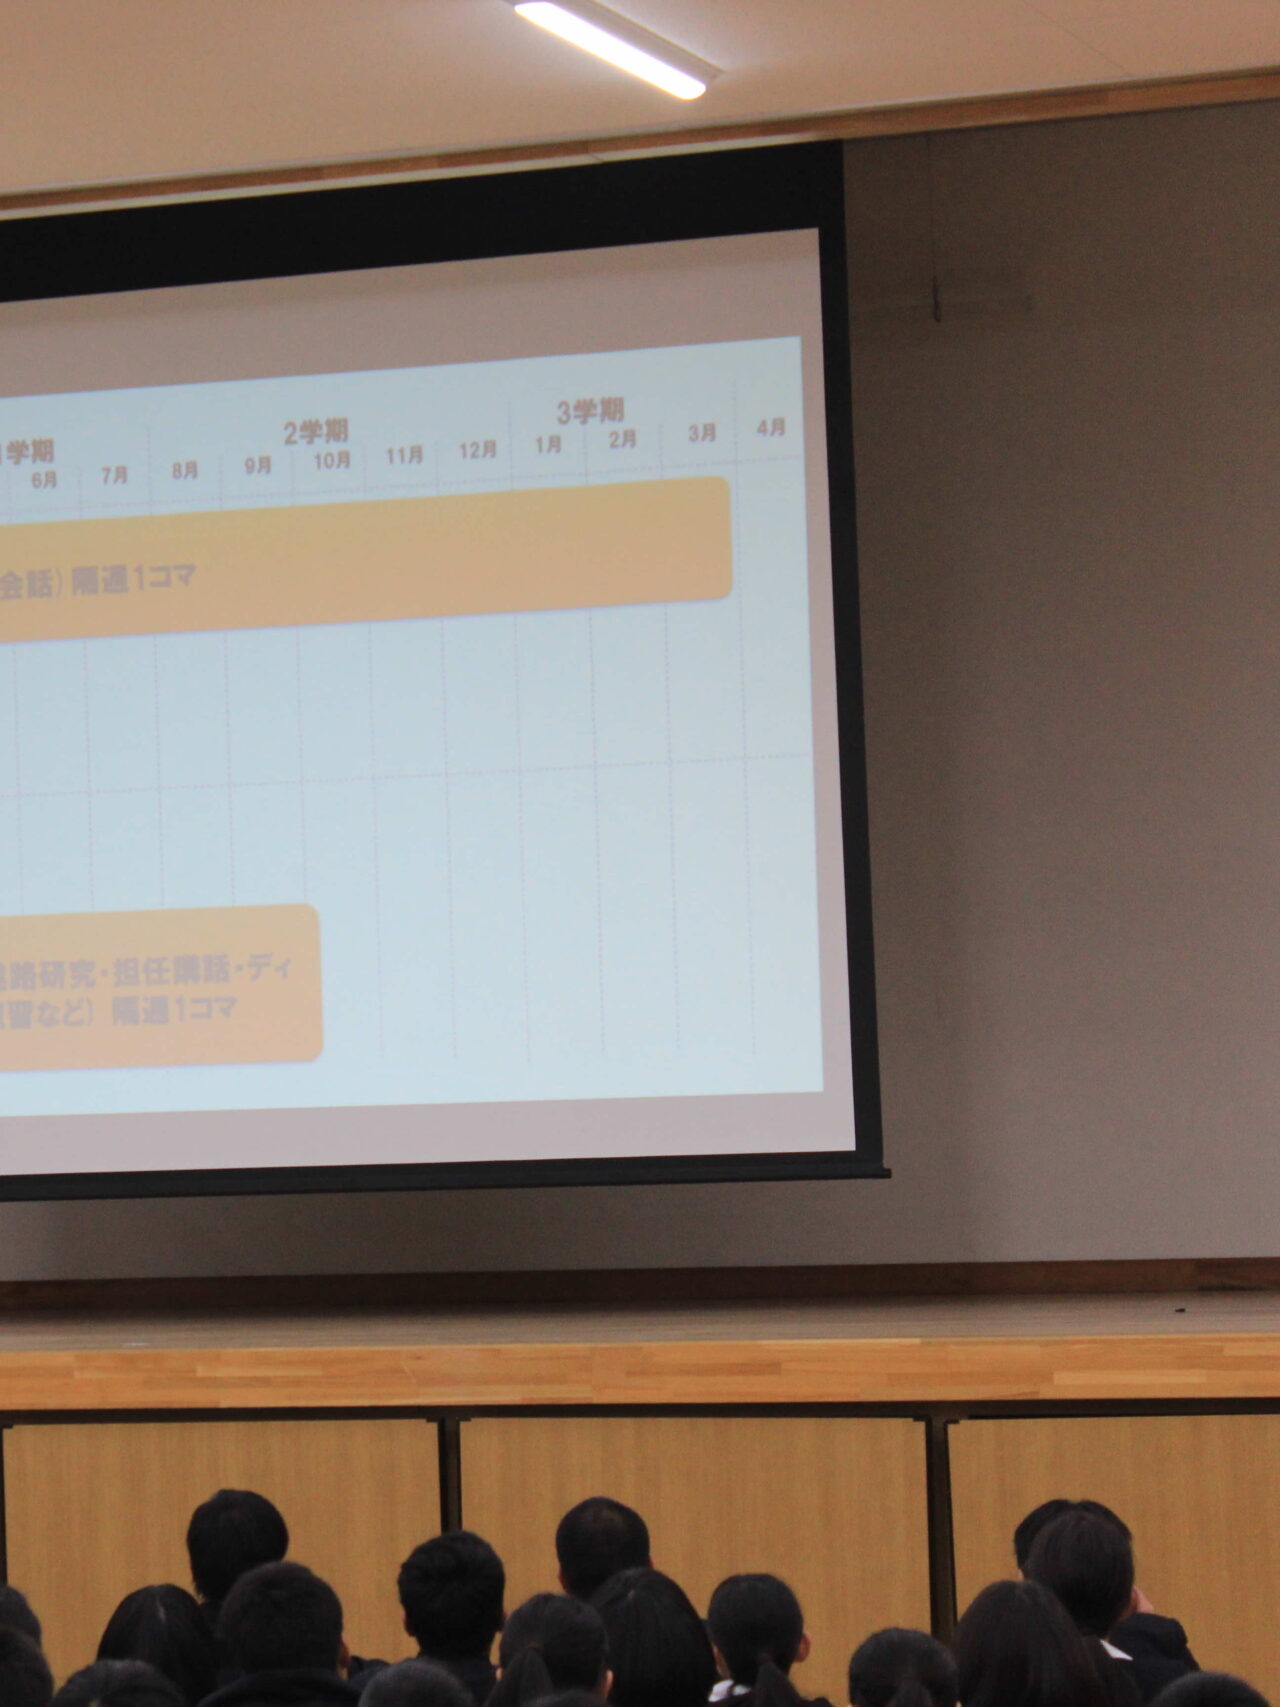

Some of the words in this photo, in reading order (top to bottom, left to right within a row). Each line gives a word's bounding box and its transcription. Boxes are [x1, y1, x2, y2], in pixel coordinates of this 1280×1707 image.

[284, 418, 348, 446] 2学期
[557, 397, 624, 426] 3学期
[32, 470, 57, 489] 6月
[102, 466, 128, 485] 7月
[172, 461, 198, 480] 8月
[244, 456, 271, 475] 9月
[314, 450, 350, 470] 10月
[387, 445, 423, 464] 11月
[460, 440, 497, 459] 12月
[536, 434, 561, 454] 1月
[609, 429, 636, 449] 2月
[689, 423, 716, 442] 3月
[757, 417, 785, 437] 4月
